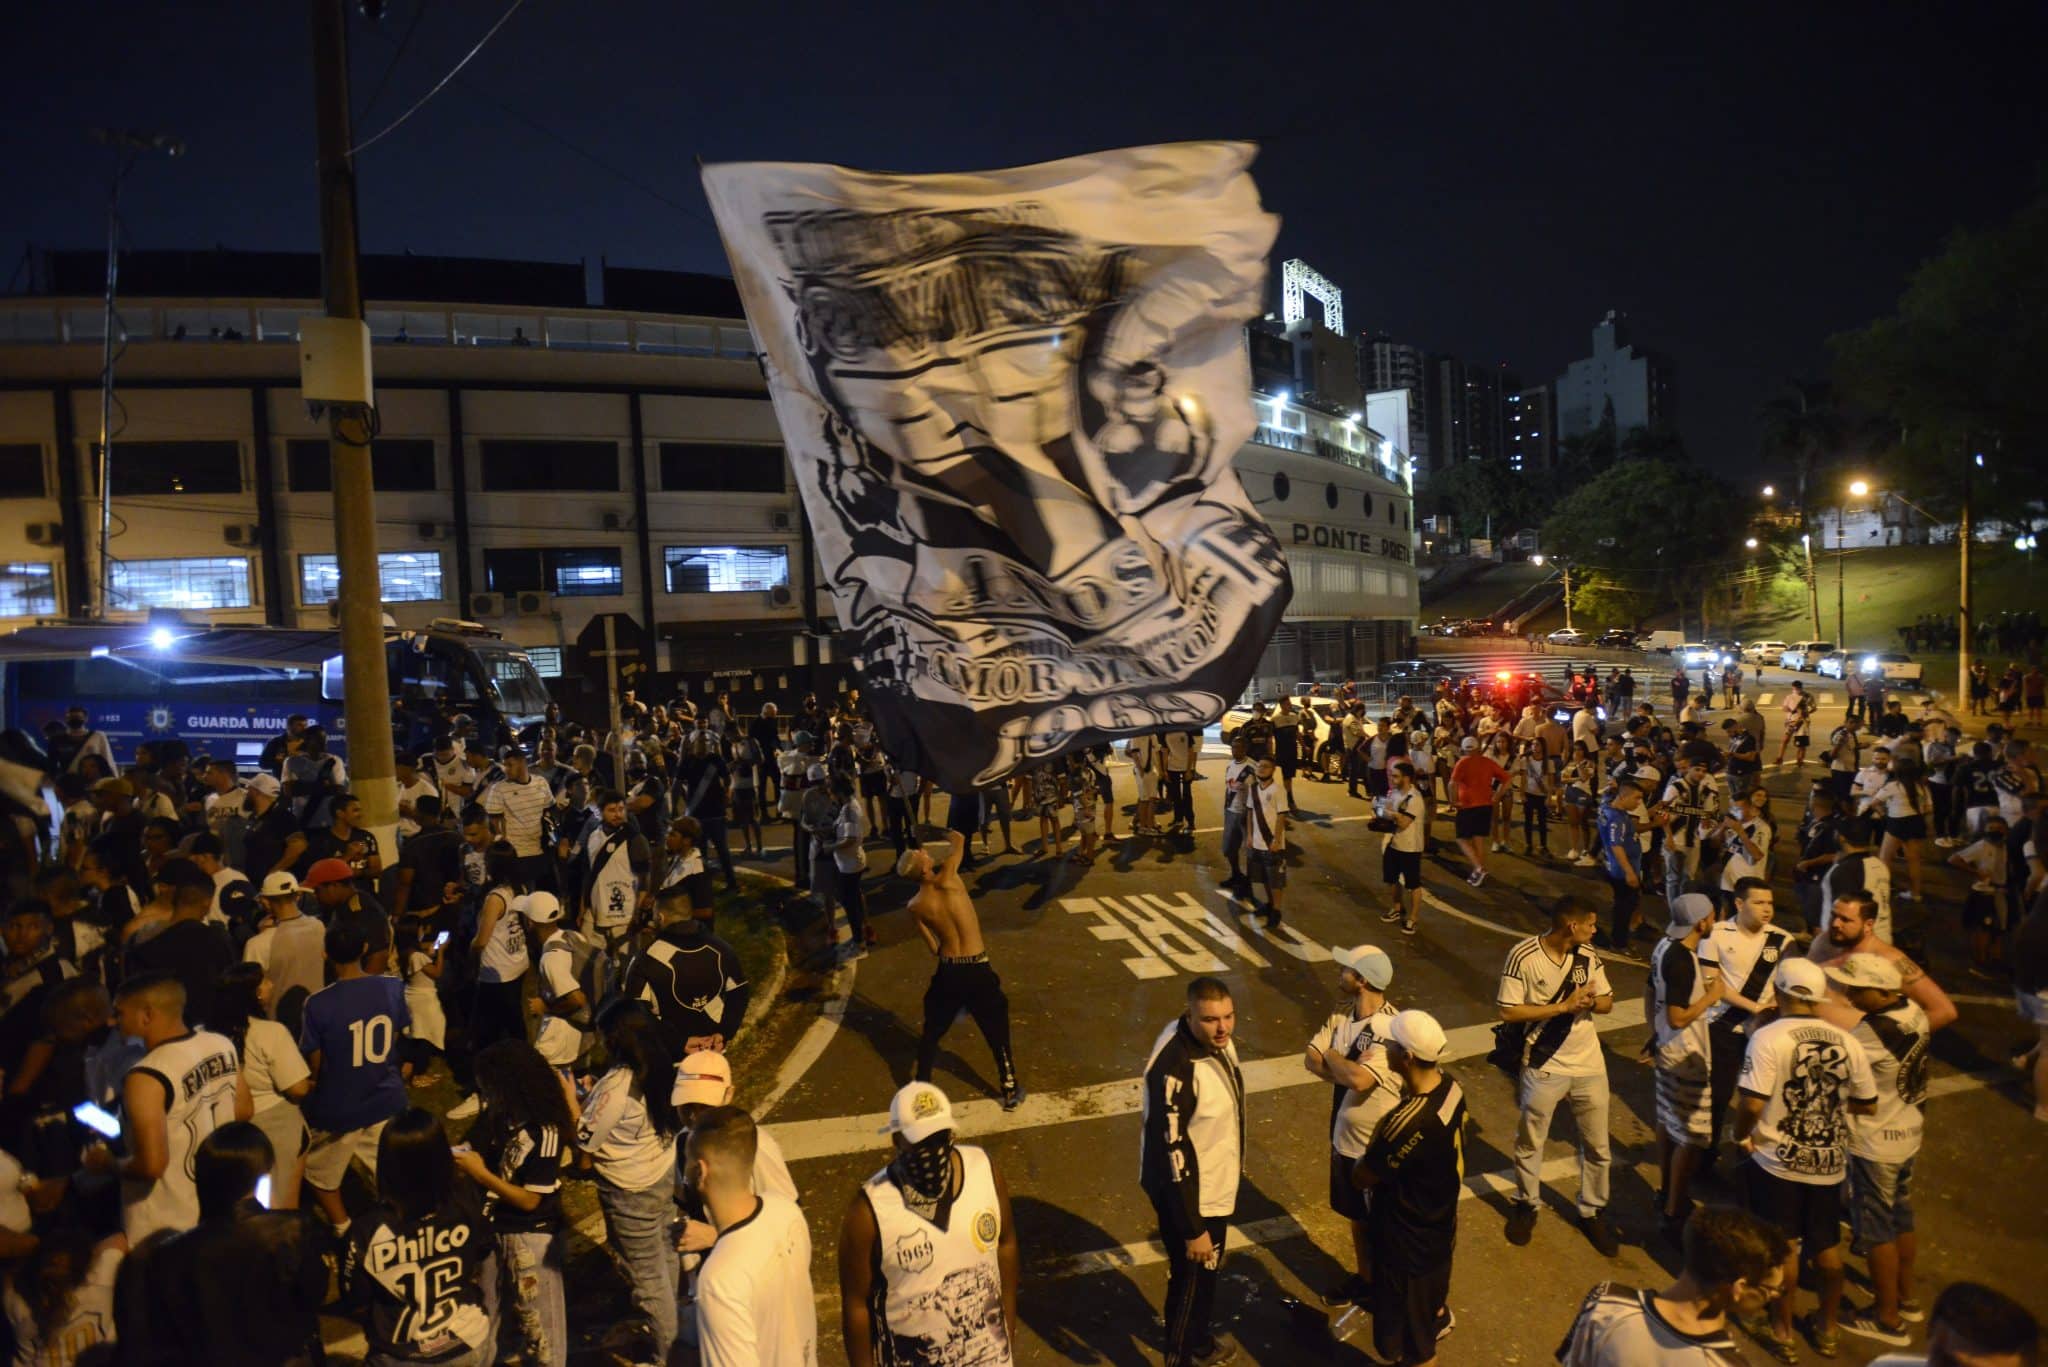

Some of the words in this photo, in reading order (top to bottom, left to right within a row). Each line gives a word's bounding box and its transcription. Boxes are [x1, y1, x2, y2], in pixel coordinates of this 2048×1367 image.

[1293, 523, 1371, 554] PONTE
[927, 647, 1064, 702] AMOR
[187, 716, 249, 730] GUARDA
[973, 690, 1227, 787] 1969
[348, 1014, 393, 1067] 10
[1796, 1042, 1848, 1080] 52
[1397, 1130, 1424, 1159] PILOT
[372, 1223, 470, 1274] Philco
[897, 1240, 934, 1266] 1969
